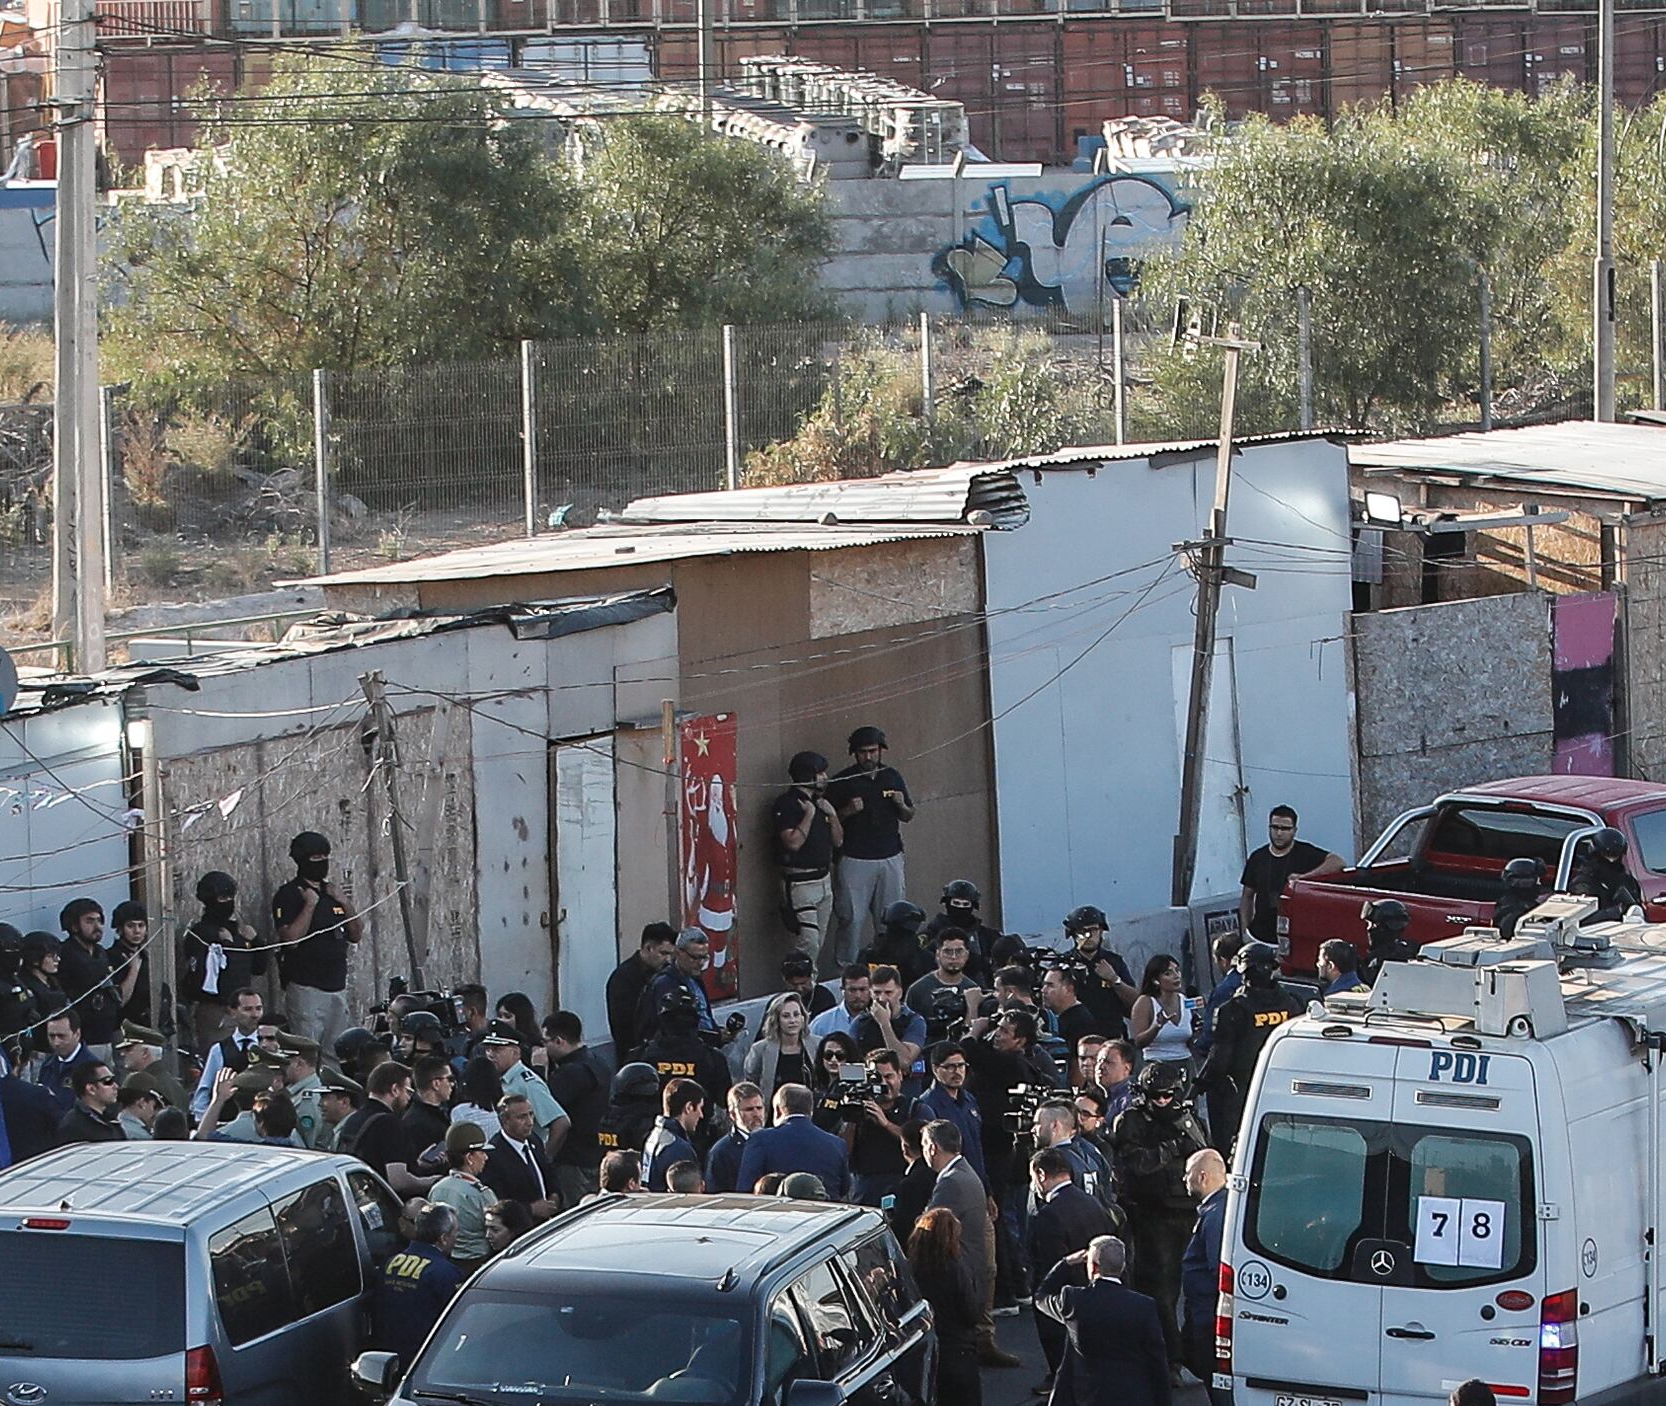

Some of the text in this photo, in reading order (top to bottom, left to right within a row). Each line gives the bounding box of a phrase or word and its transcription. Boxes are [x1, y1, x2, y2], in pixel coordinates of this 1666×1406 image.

[1254, 1010, 1291, 1027] PDI
[657, 1062, 695, 1076] PDI
[1428, 1051, 1491, 1085] PDI
[598, 1133, 619, 1147] PDI
[1431, 1212, 1492, 1239] 7 8
[384, 1252, 431, 1280] PDI
